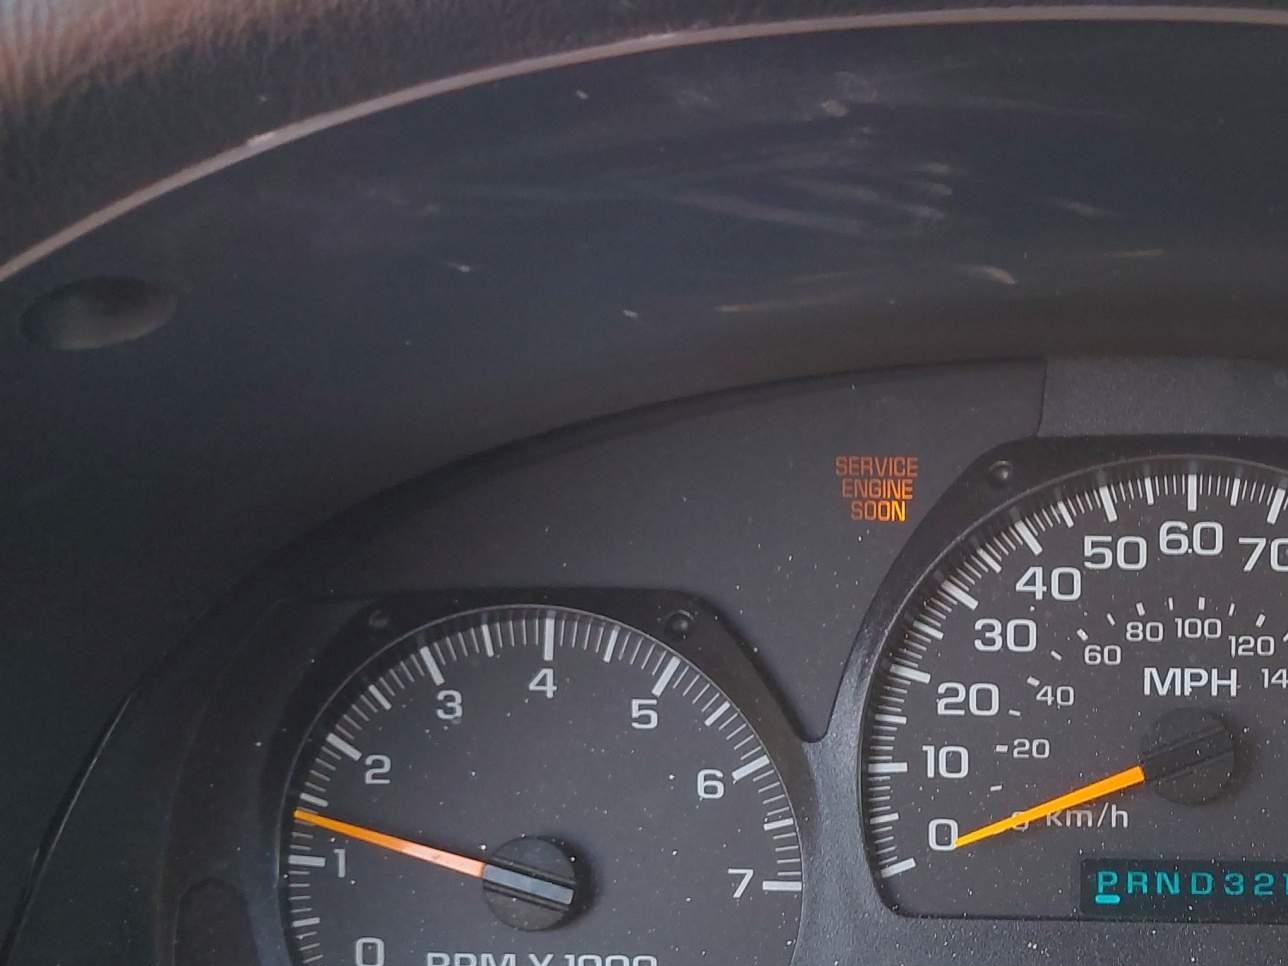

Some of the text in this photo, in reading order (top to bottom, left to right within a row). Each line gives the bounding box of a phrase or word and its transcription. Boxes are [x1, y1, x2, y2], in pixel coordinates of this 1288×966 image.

[835, 456, 918, 477] SERVICE
[841, 479, 913, 500] ENGINE
[850, 500, 906, 522] SOON
[1084, 535, 1147, 570] 50
[1159, 521, 1223, 556] 60
[1015, 566, 1082, 601] 40
[974, 618, 1037, 652] 30
[1126, 621, 1164, 642] 80
[1174, 617, 1222, 640] 100
[1084, 644, 1122, 666] 60
[1228, 635, 1275, 657] 120
[528, 668, 558, 699] 4
[1035, 685, 1075, 706] 40
[1143, 667, 1237, 697] MPH
[436, 689, 463, 720] 3
[631, 698, 658, 729] 5
[936, 682, 1000, 716] 20
[922, 745, 969, 779] 10
[1013, 738, 1050, 759] 20
[364, 754, 391, 785] 2
[697, 769, 725, 801] 6
[1046, 802, 1129, 828] km/h
[928, 818, 959, 851] 0
[333, 848, 346, 878] 1
[727, 868, 754, 898] 7
